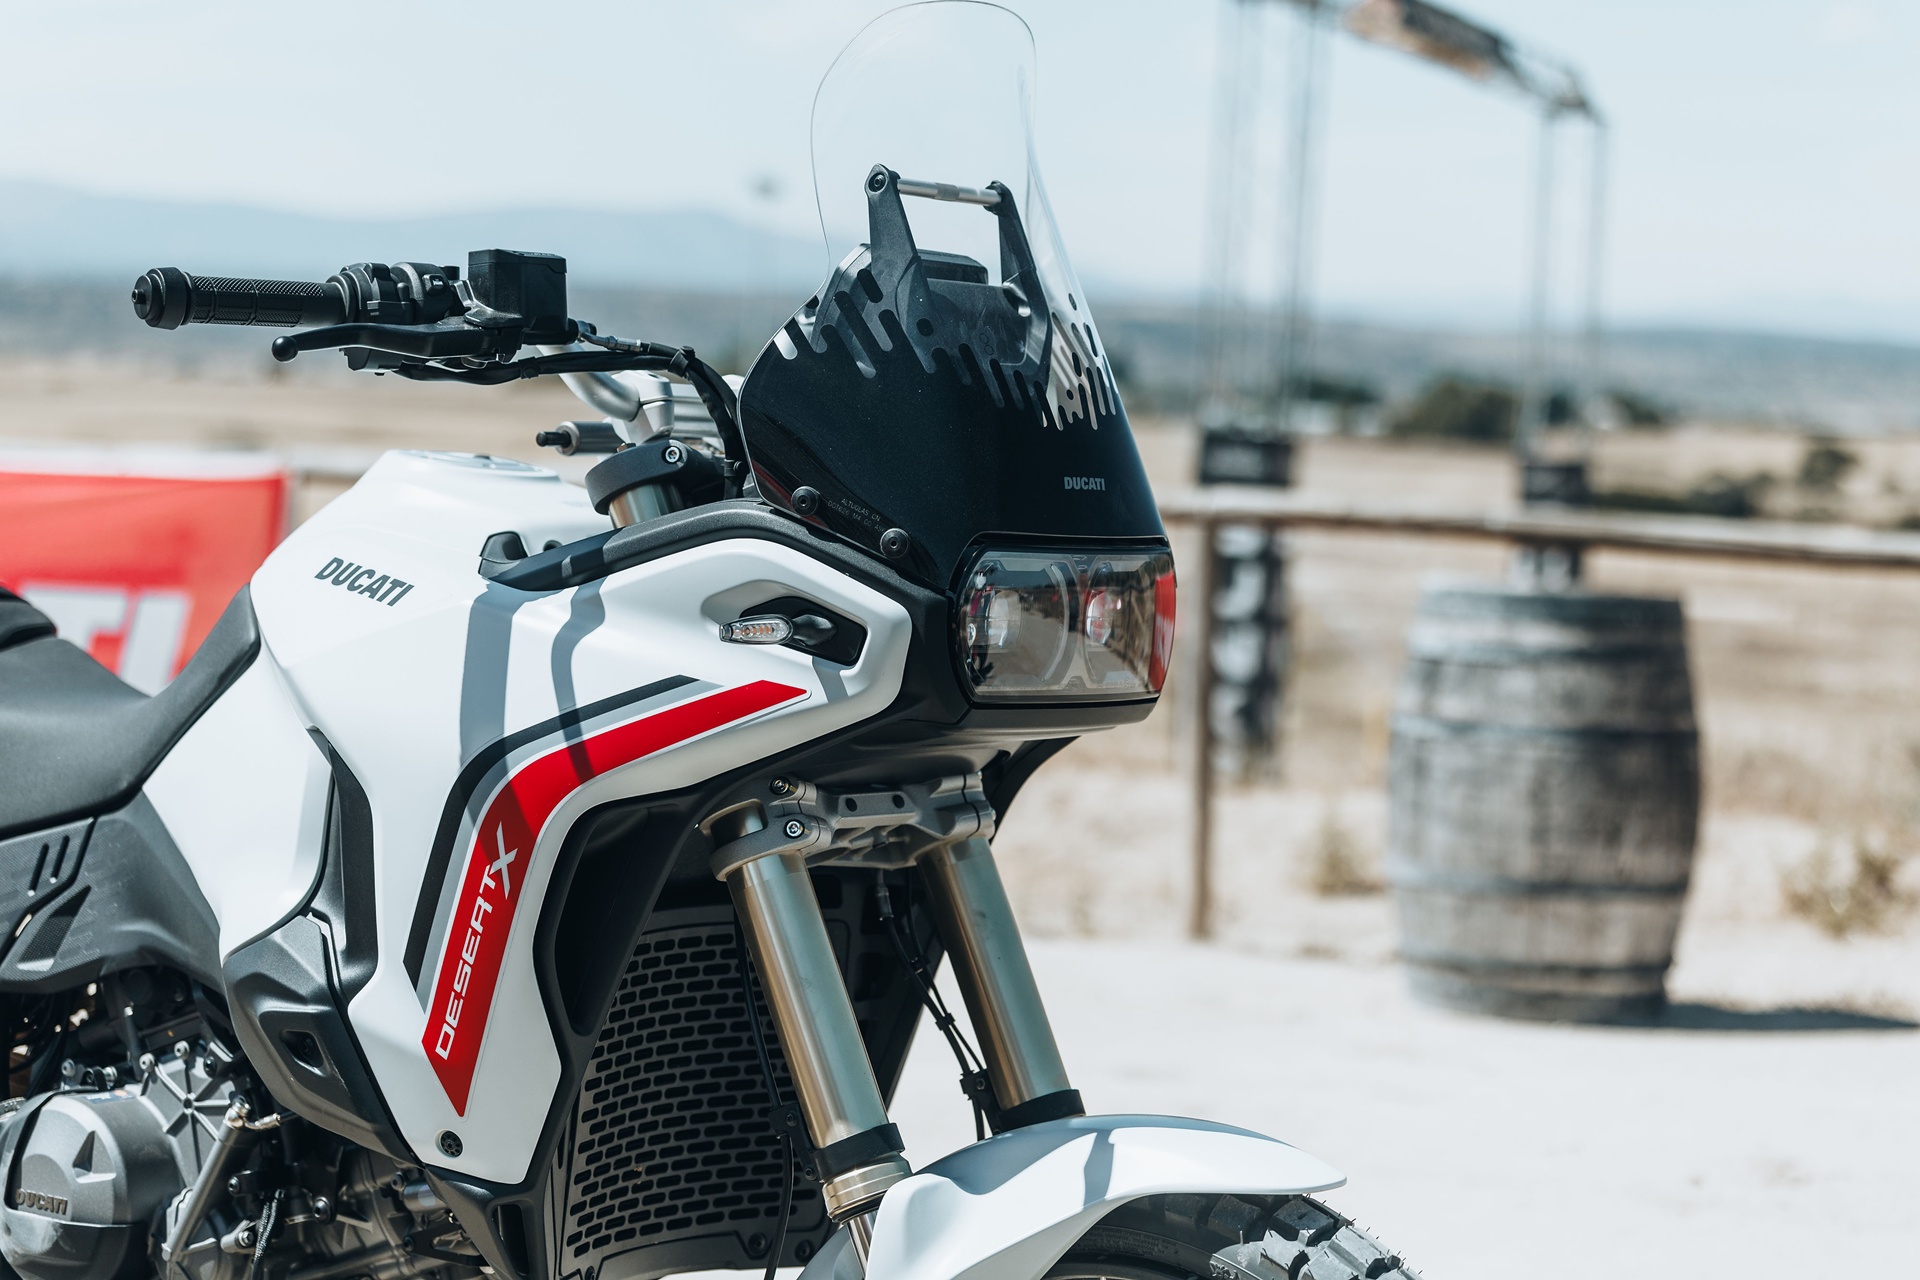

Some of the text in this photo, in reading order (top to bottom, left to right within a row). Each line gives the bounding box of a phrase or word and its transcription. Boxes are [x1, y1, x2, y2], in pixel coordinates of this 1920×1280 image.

[1064, 476, 1106, 491] DUCATI
[841, 498, 870, 516] ALTUGLAS
[314, 556, 415, 607] DUCATI
[15, 1188, 69, 1216] DUCATI
